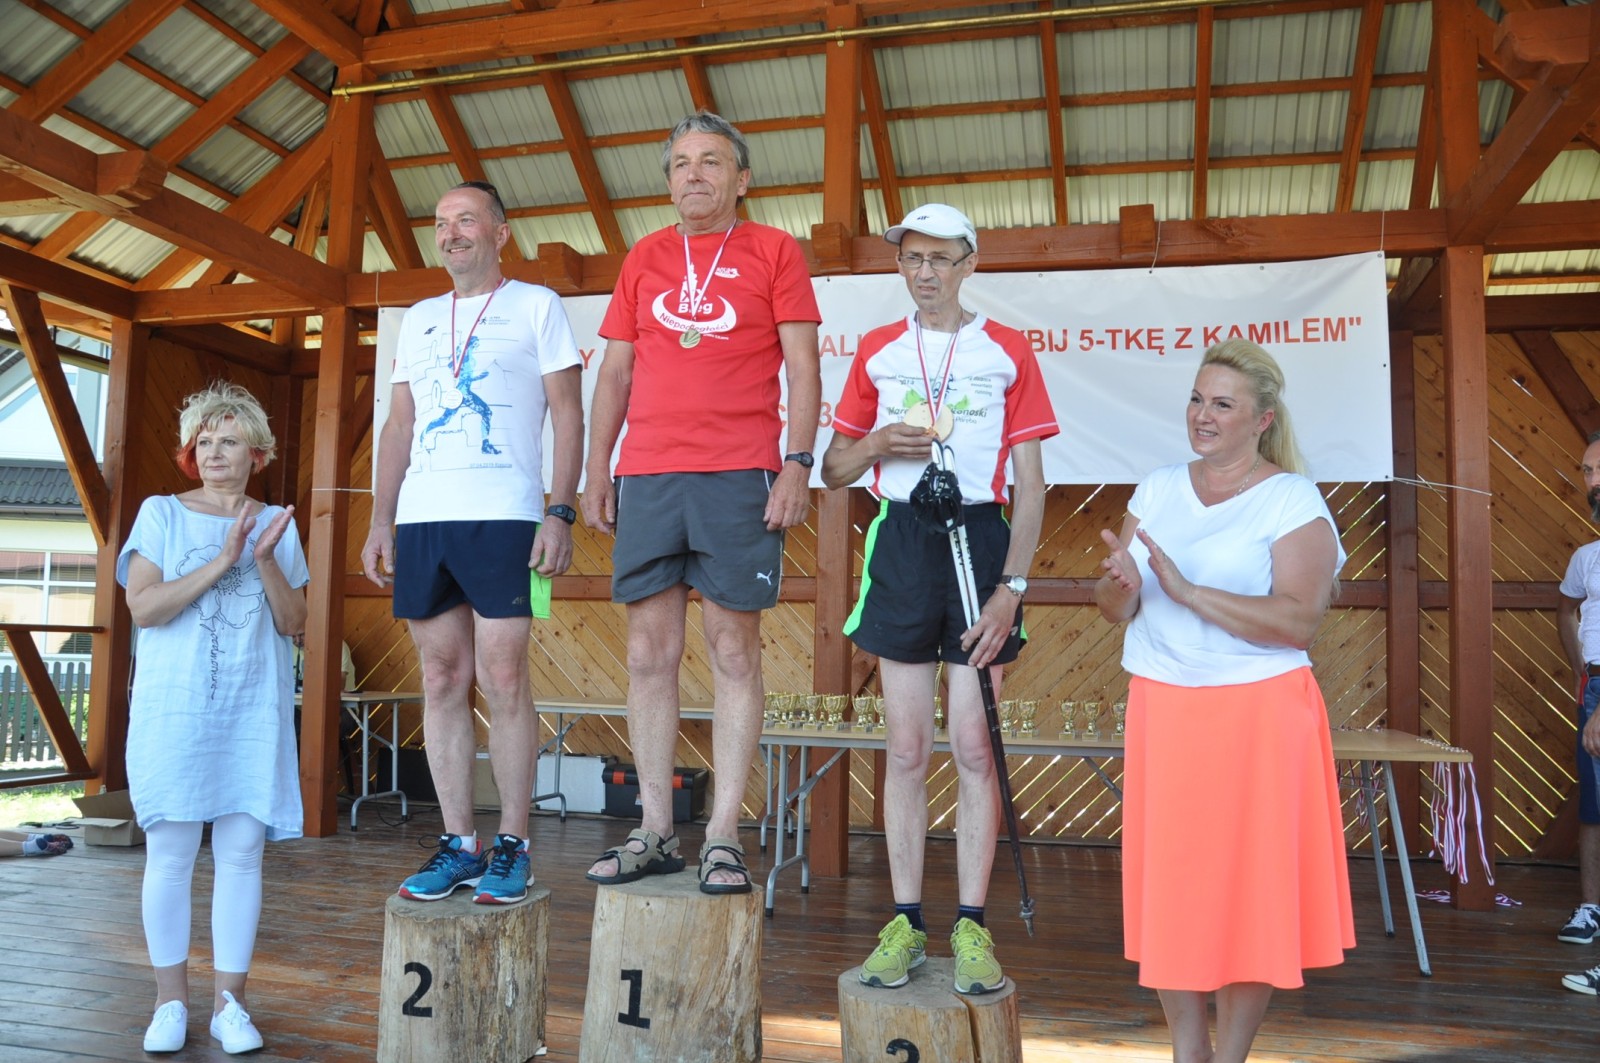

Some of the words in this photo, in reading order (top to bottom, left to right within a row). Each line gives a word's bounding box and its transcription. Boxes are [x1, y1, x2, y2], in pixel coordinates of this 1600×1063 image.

[678, 303, 714, 315] Beg
[1079, 328, 1165, 355] 5-TKĘ
[1174, 327, 1193, 349] Z
[402, 961, 433, 1018] 2
[617, 968, 651, 1030] 1
